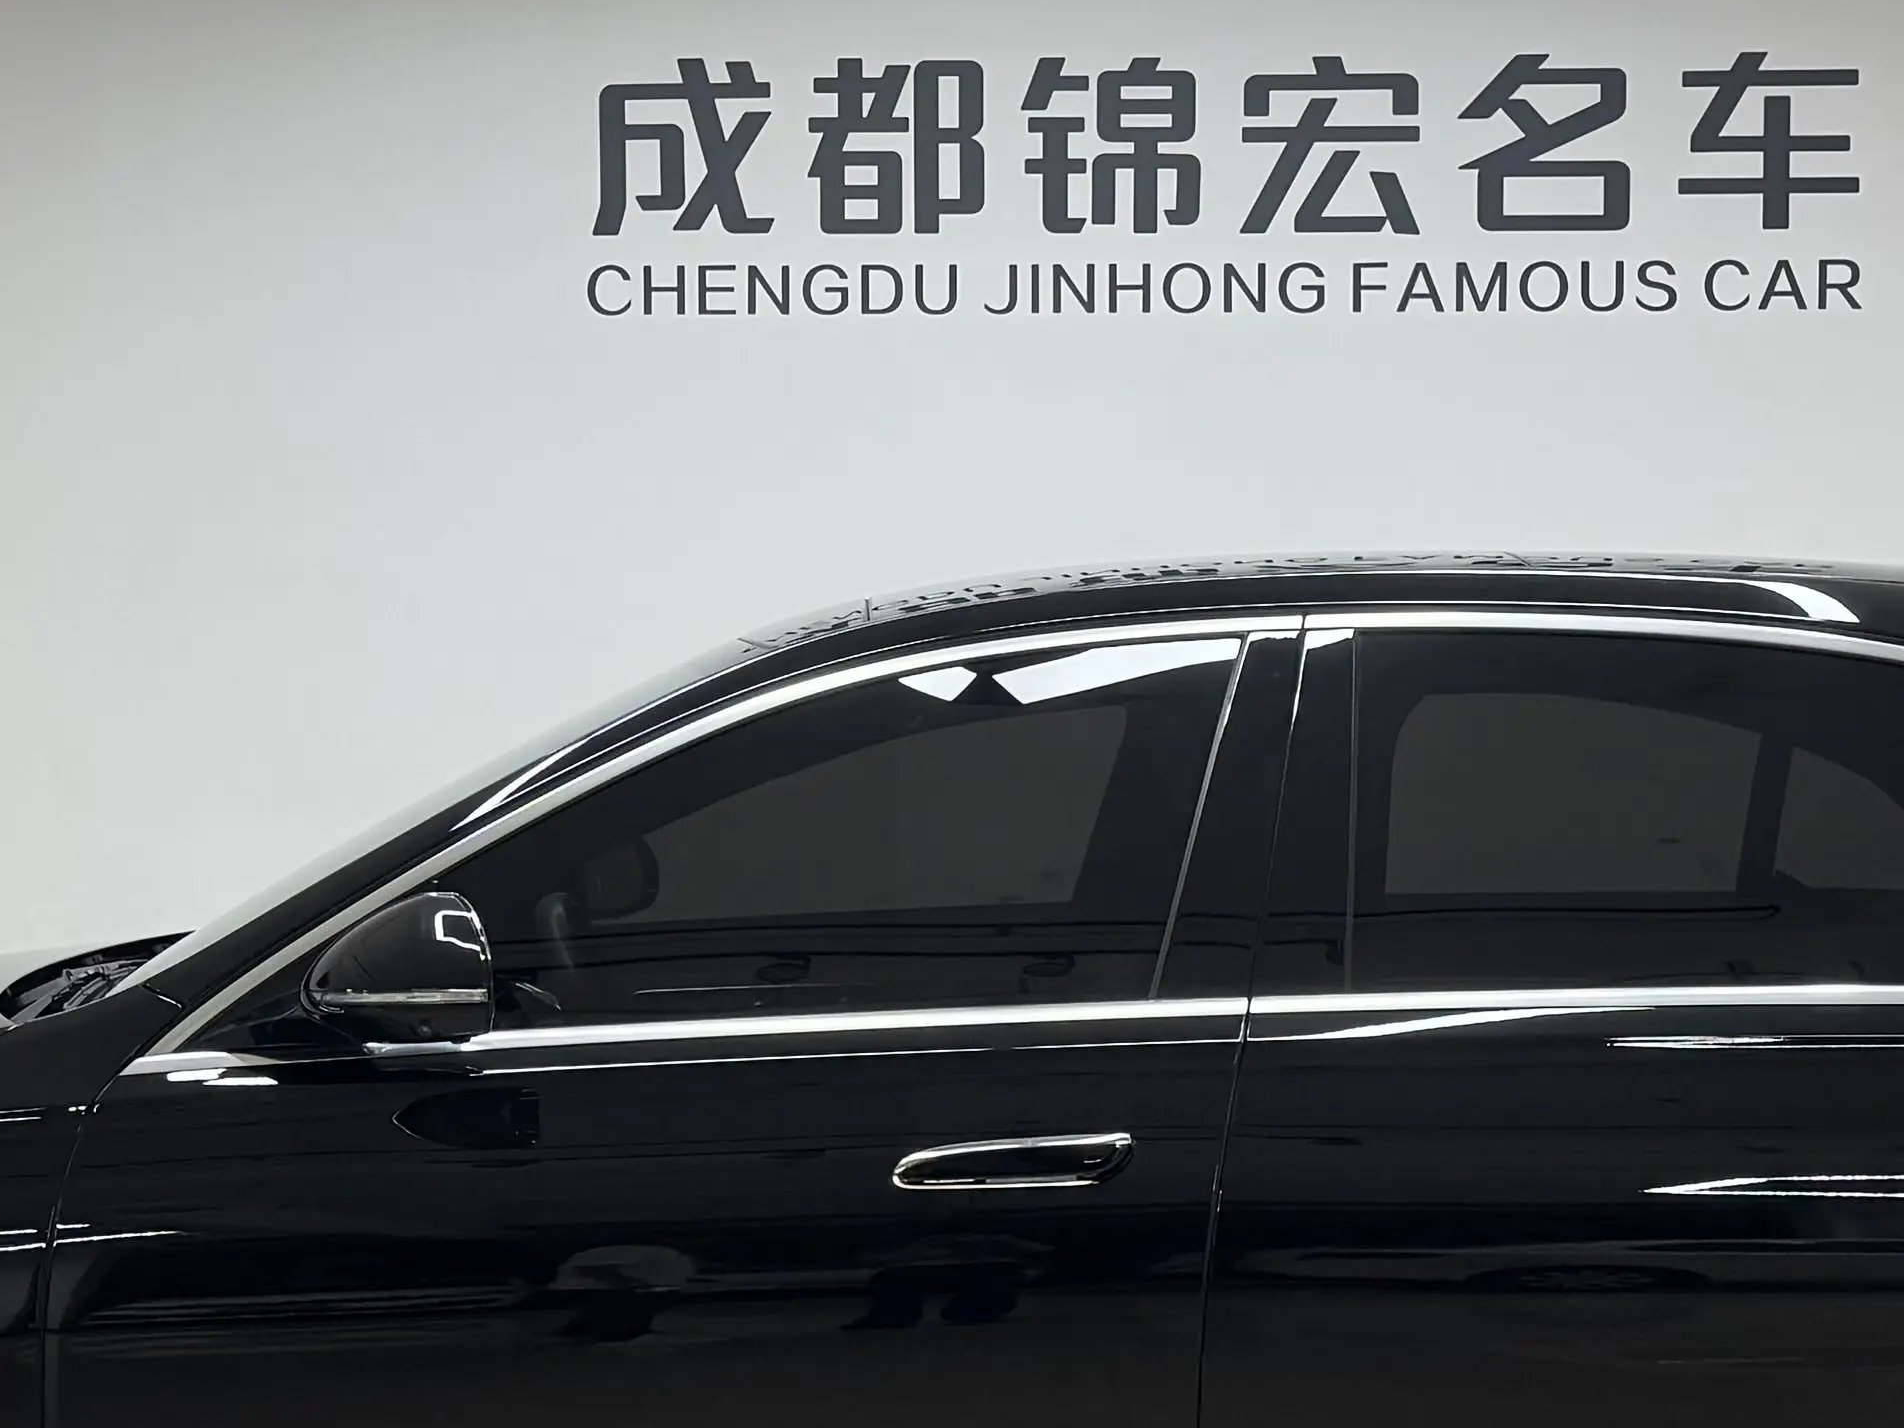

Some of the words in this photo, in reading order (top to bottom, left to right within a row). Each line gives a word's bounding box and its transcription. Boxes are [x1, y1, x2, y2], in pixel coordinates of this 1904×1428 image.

[591, 50, 1861, 237] 成都锦宏名车
[586, 262, 959, 317] CHENGDU
[982, 261, 1326, 316] JINHONG
[1351, 259, 1679, 314] FAMOUS
[1703, 258, 1863, 313] CAR
